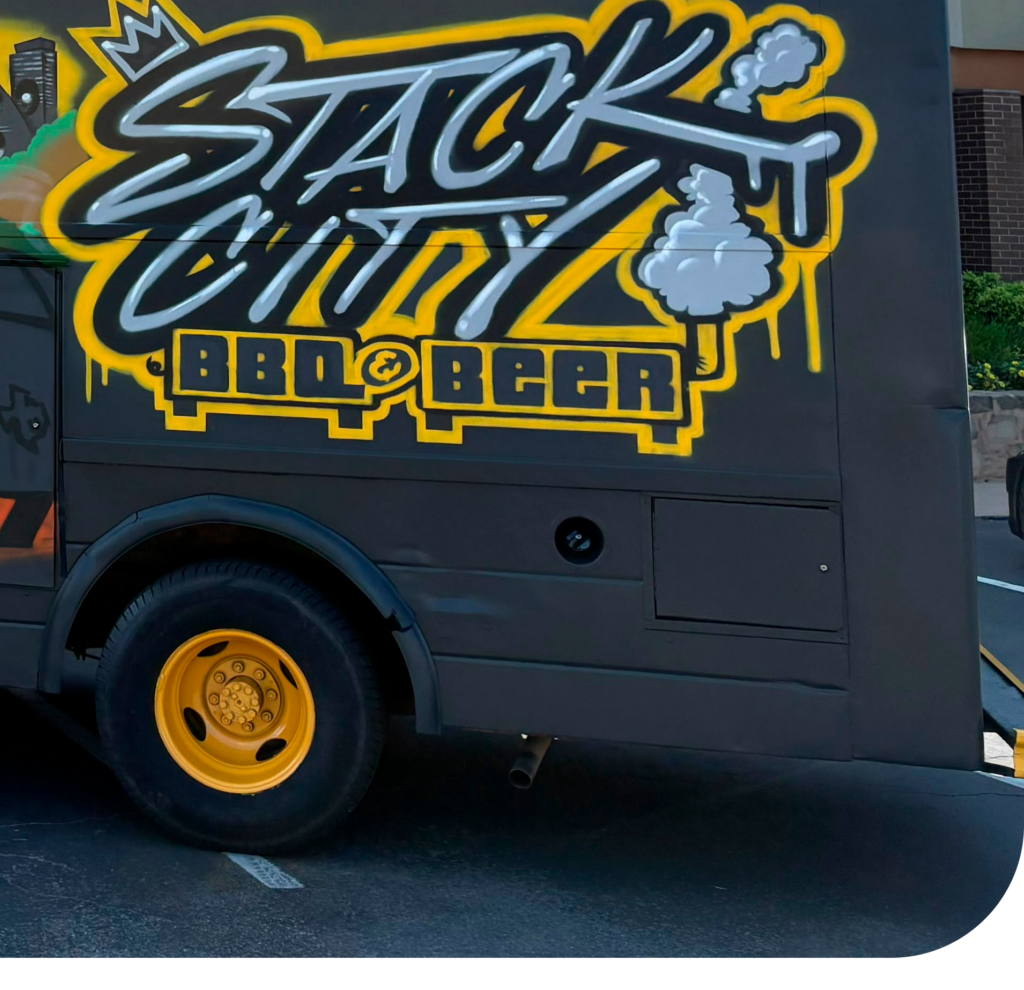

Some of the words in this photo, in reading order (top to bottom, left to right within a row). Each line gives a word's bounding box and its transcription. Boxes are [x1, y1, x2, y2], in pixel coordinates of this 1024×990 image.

[86, 16, 842, 237] STACK
[118, 157, 661, 341] CITY
[179, 333, 366, 399] BBQ
[368, 349, 403, 382] &
